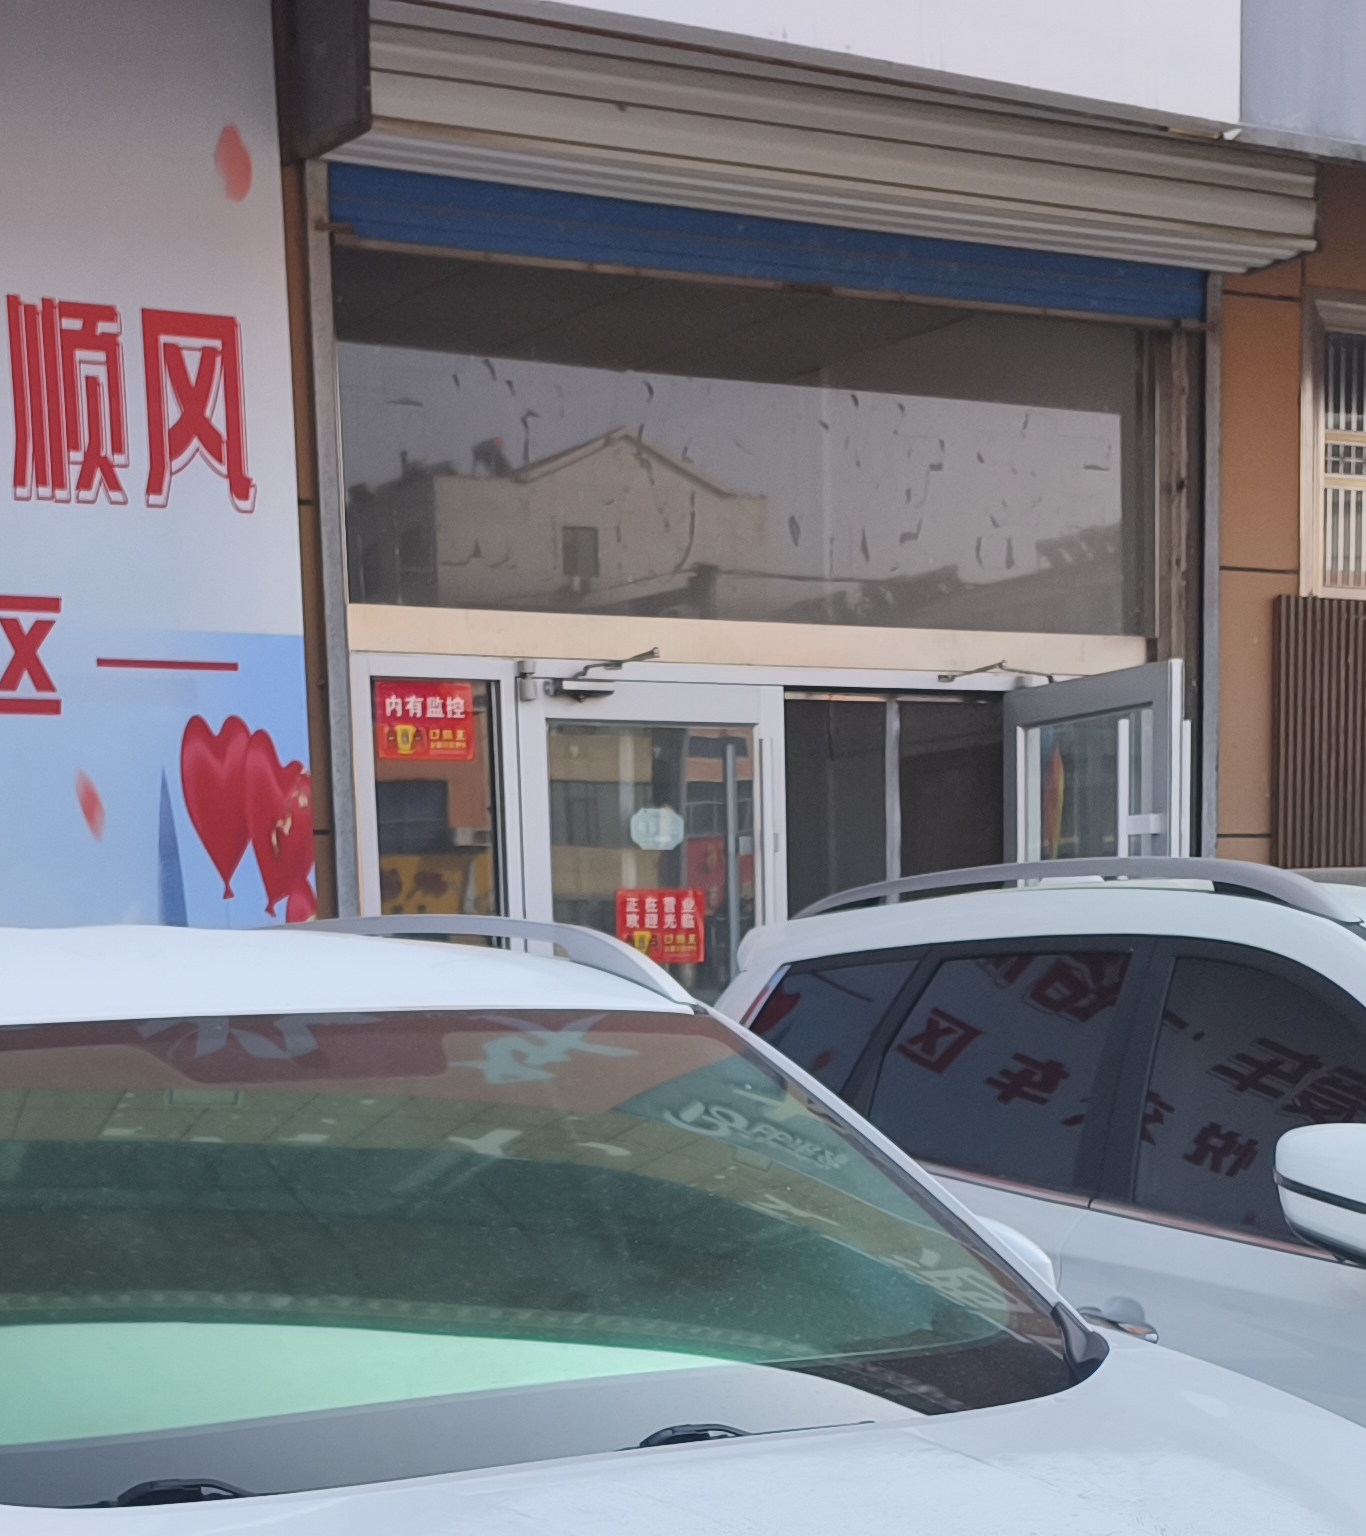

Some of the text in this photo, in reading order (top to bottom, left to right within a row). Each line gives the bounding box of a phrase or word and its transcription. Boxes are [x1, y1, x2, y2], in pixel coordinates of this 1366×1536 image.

[384, 693, 466, 719] 内有监控
[625, 896, 695, 912] 正在营业
[625, 912, 695, 930] 欢迎光临
